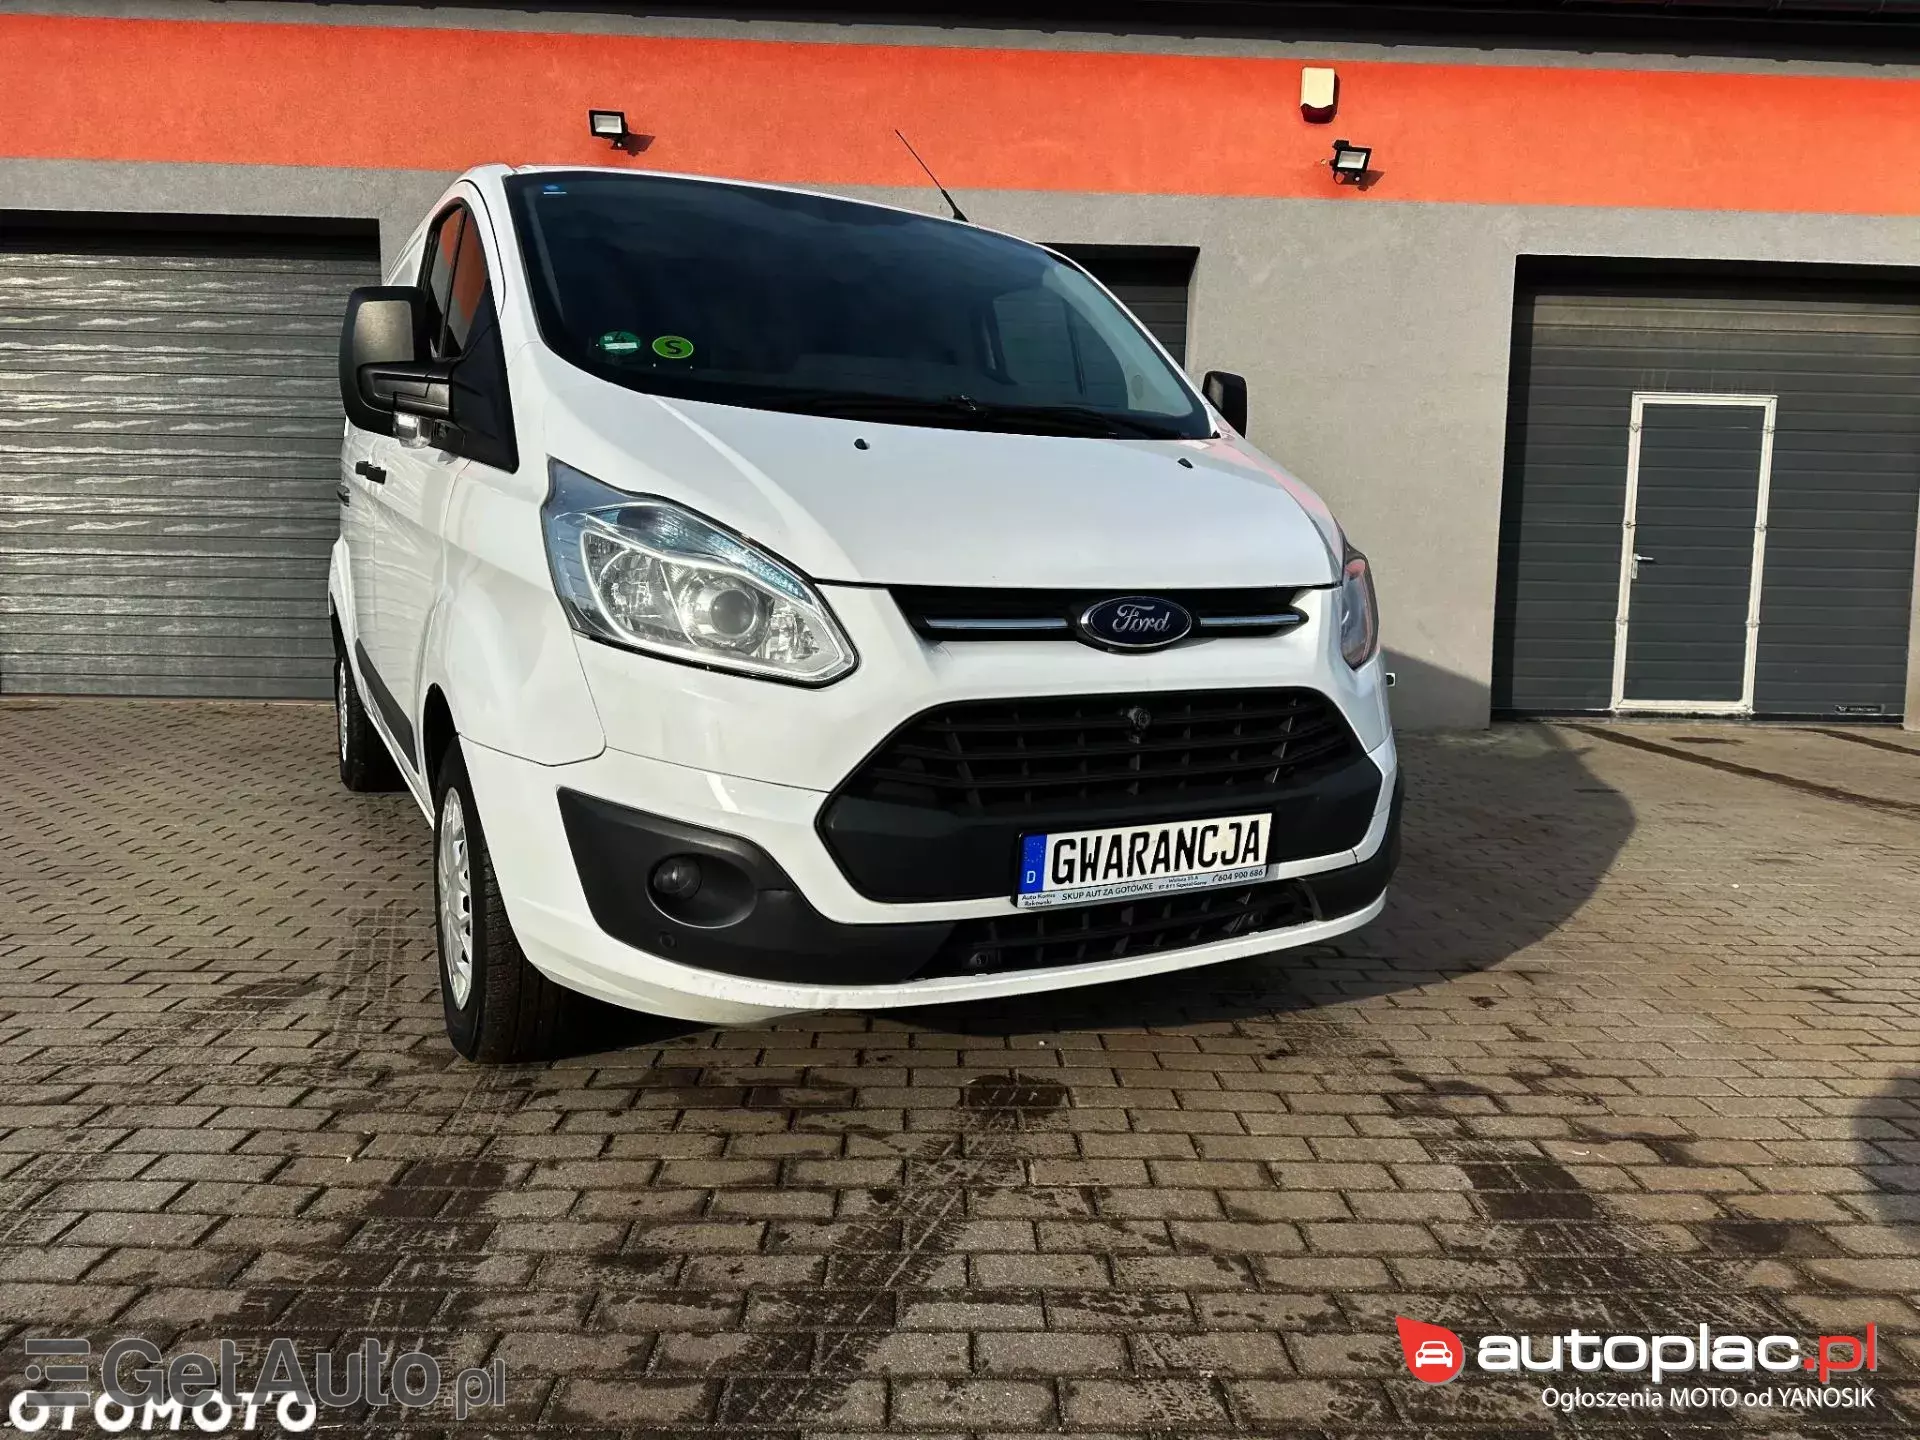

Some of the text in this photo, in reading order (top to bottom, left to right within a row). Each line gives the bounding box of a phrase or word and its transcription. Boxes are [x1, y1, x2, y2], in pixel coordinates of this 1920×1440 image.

[665, 340, 682, 354] S
[1112, 603, 1170, 632] Ford
[1051, 820, 1259, 885] GWARANCJA
[1026, 870, 1036, 884] D
[1218, 868, 1264, 882] 604 900 686
[1062, 891, 1084, 901] SKUP
[1085, 889, 1102, 898] AUT
[1103, 887, 1114, 896] ZA
